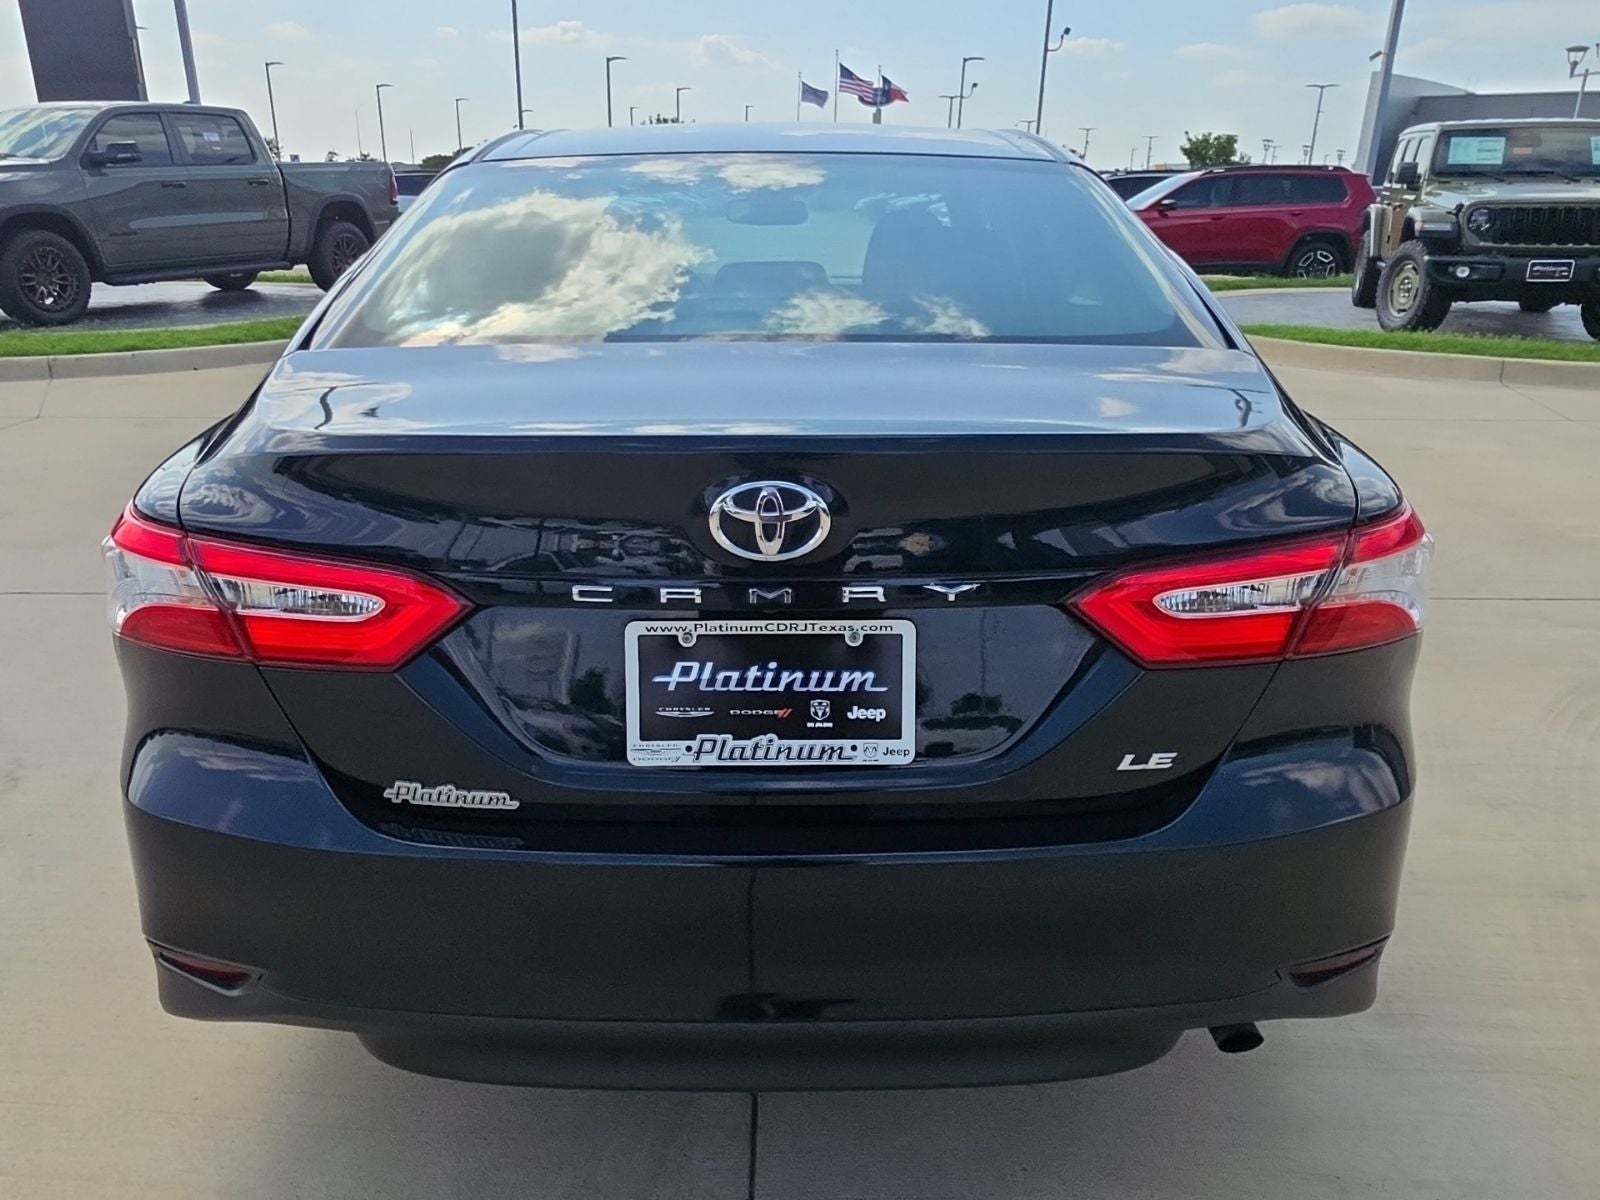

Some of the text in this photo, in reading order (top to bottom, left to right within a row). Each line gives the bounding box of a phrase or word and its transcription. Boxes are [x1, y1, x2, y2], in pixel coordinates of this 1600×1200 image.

[572, 583, 981, 604] CAMRY
[645, 622, 893, 633] www.PlatinumCDRJTexas.com
[652, 661, 888, 692] Platinum
[846, 705, 887, 722] Jeep
[692, 736, 857, 762] Platinum
[882, 747, 910, 757] Jeep
[1116, 752, 1178, 771] LE
[384, 779, 520, 810] Platinum
